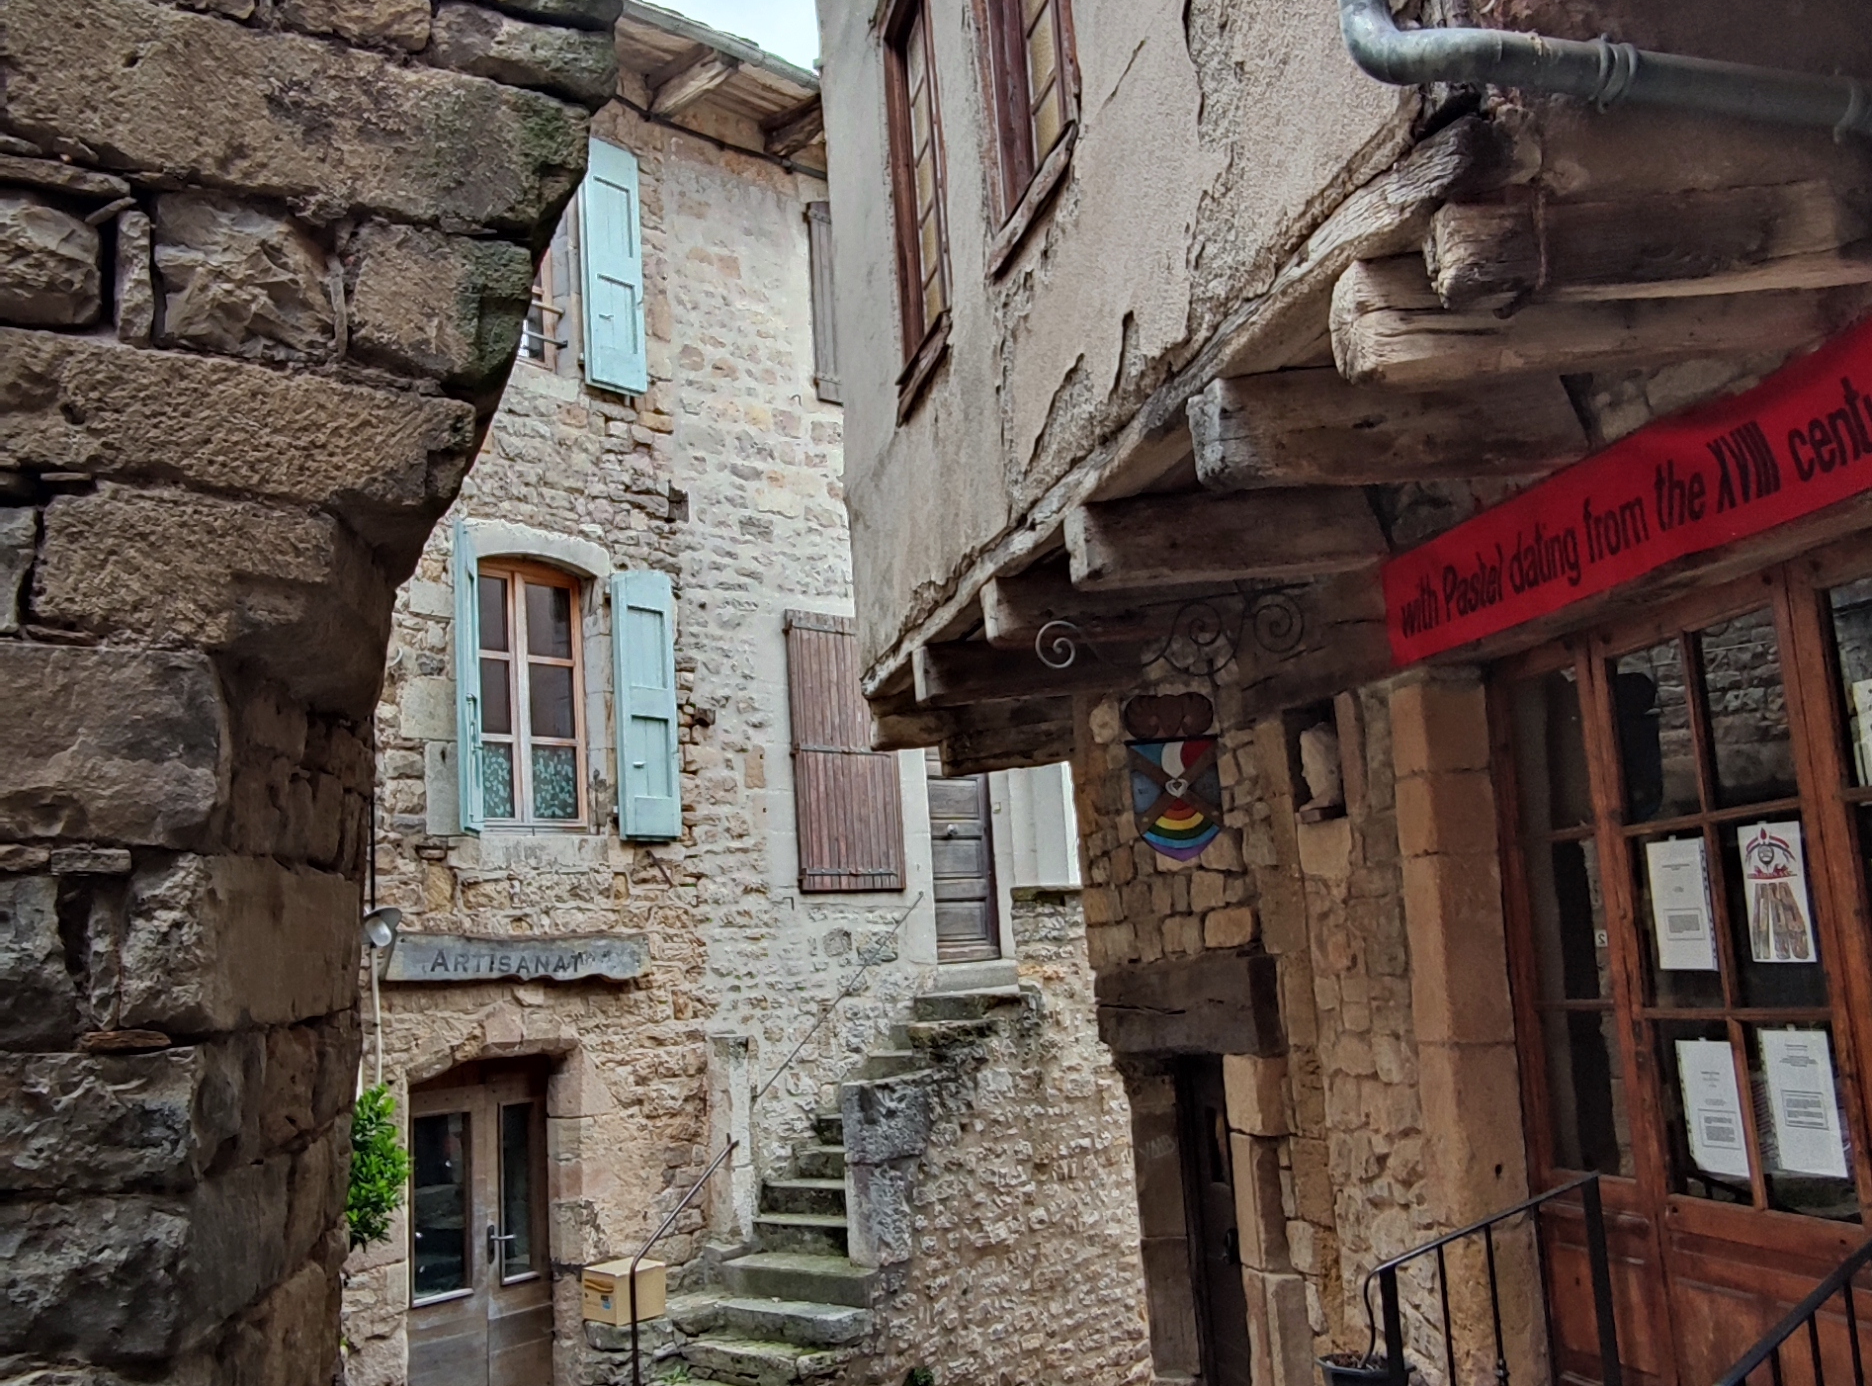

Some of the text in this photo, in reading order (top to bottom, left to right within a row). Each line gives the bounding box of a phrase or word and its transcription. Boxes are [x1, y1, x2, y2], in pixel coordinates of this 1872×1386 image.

[1401, 575, 1438, 638] with
[1443, 542, 1504, 618] Pastel
[1509, 524, 1582, 595] dating
[1583, 497, 1651, 563] from
[1655, 460, 1706, 530] the
[1706, 420, 1781, 513] XVIII
[430, 948, 581, 974] ARTISANAT
